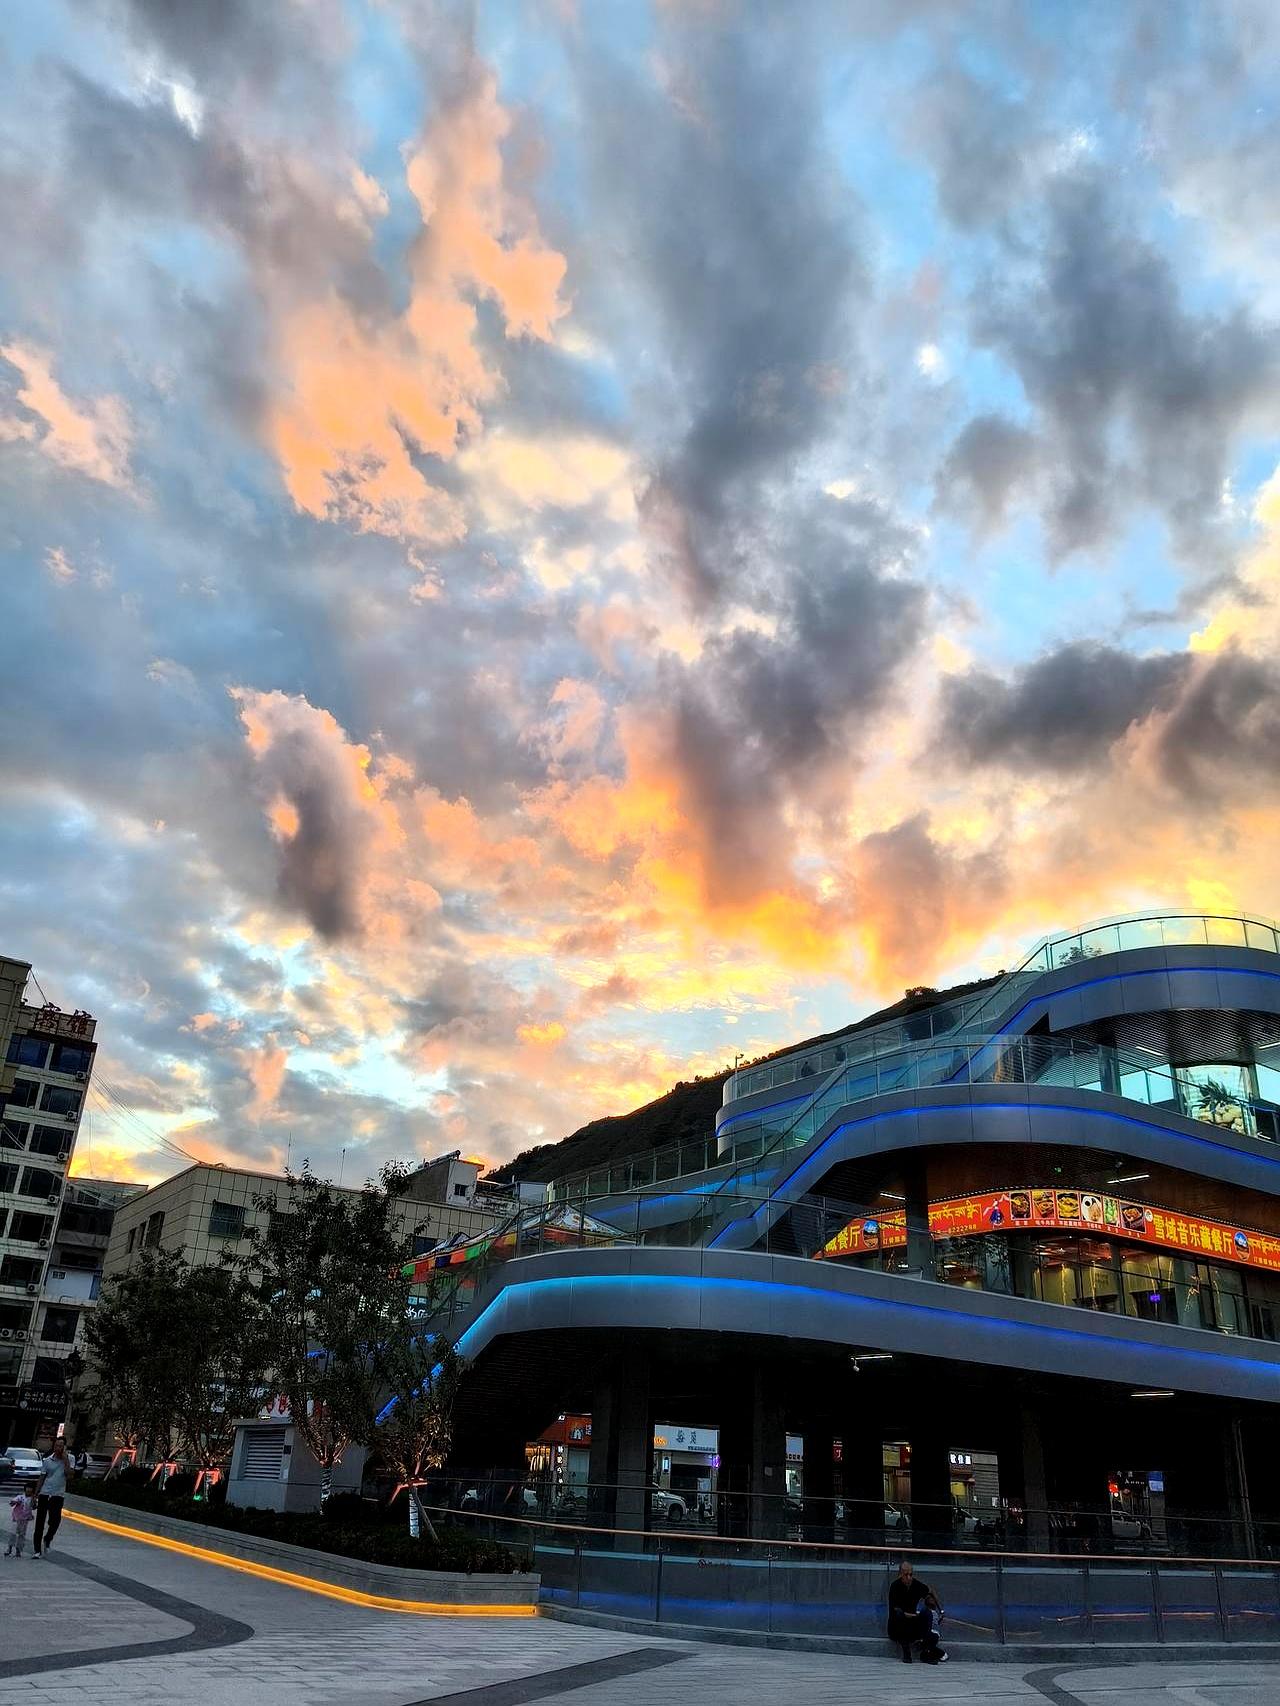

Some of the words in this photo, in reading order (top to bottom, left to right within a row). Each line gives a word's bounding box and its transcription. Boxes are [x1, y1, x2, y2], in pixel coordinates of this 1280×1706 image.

[1153, 1214, 1233, 1255] 雪域音乐藏餐厅
